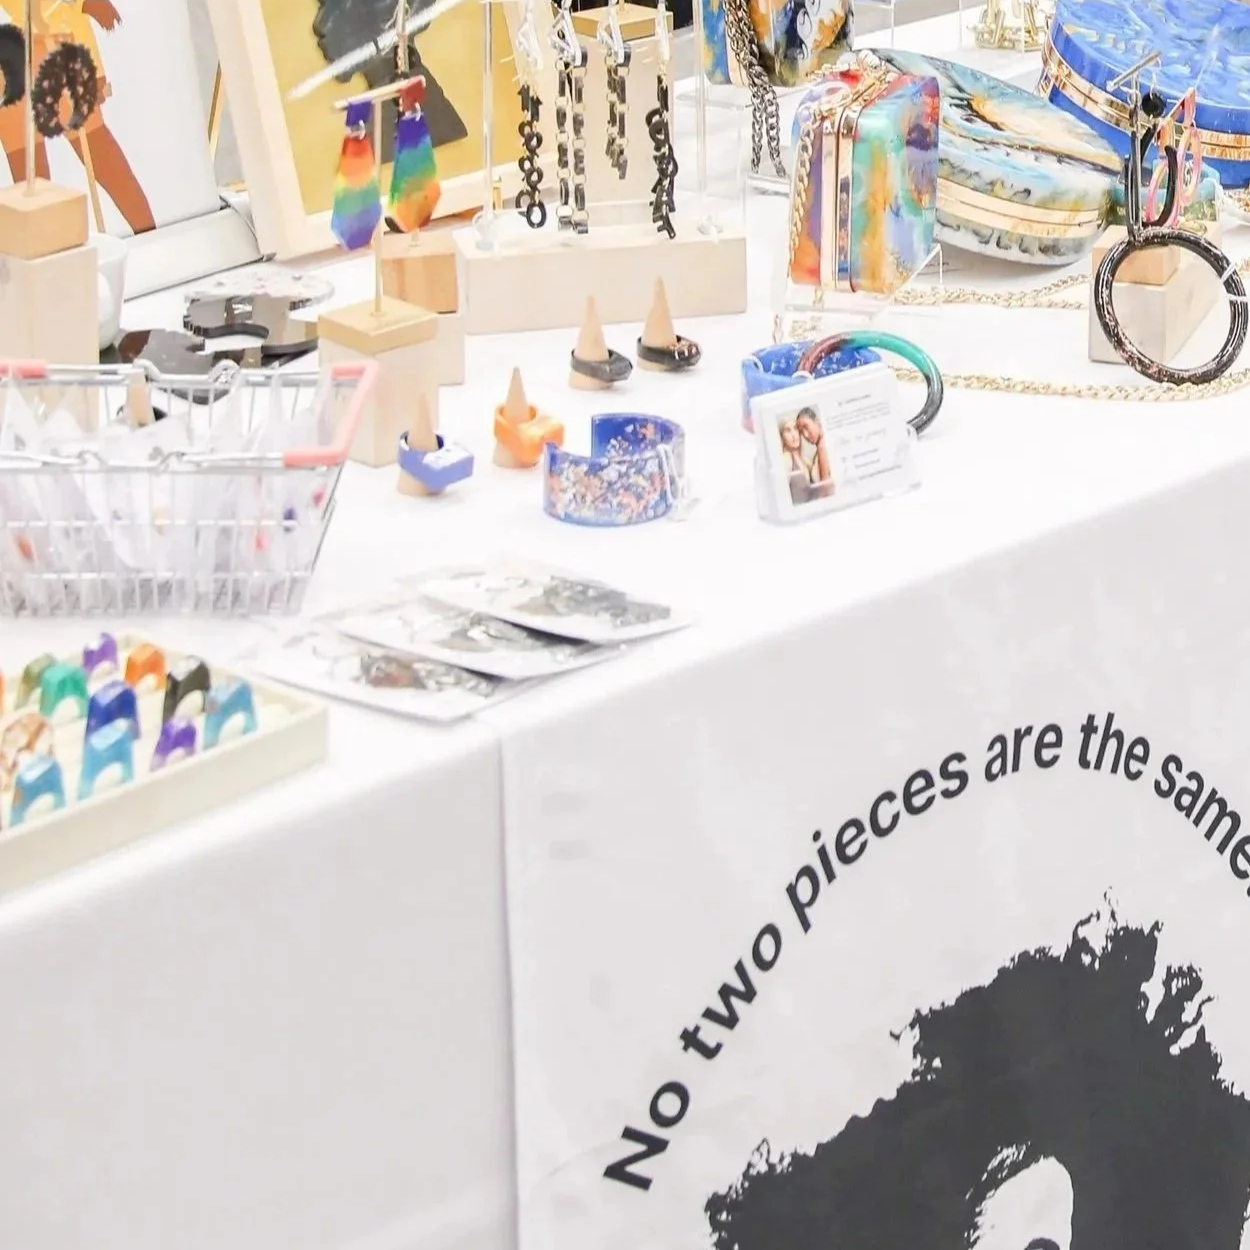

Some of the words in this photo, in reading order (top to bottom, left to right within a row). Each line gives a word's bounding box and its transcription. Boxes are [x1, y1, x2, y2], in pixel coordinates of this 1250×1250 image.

[603, 1082, 690, 1190] No
[680, 924, 782, 1059] two
[786, 753, 968, 933] pieces
[984, 723, 1063, 783] are
[1078, 711, 1150, 781] the
